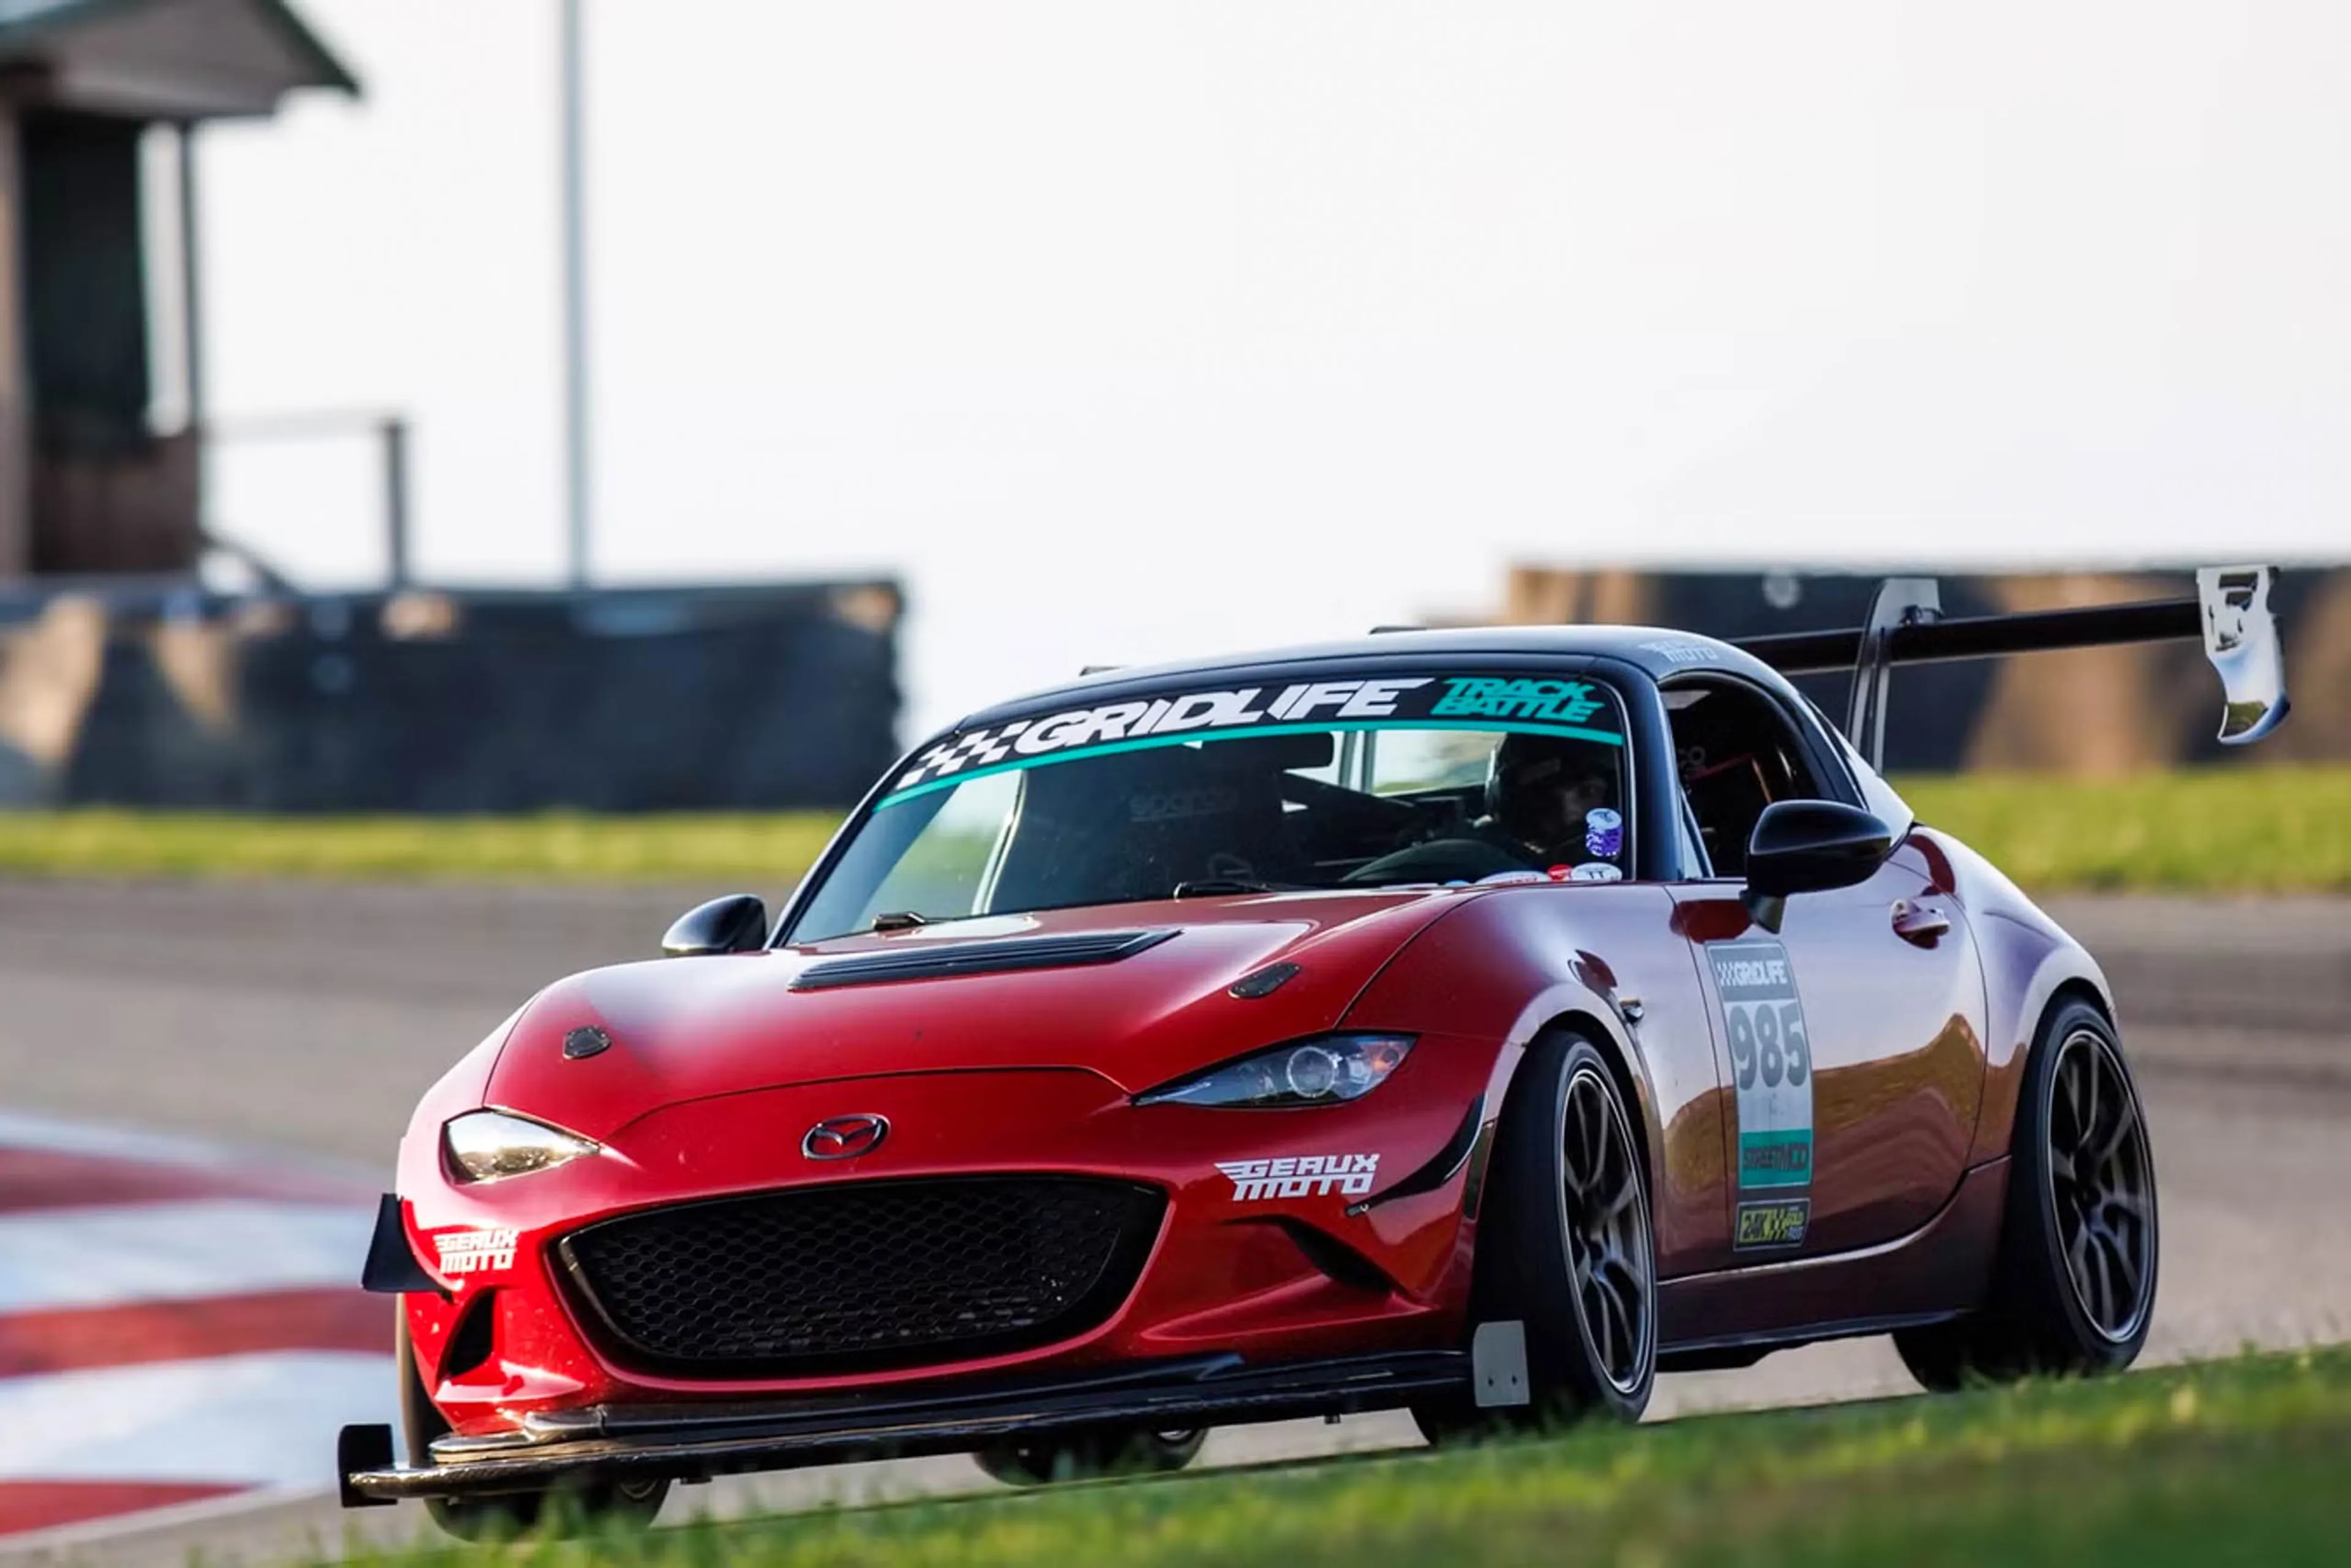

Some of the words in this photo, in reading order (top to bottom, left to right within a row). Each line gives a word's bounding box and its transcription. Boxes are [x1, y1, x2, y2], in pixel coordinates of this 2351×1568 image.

[1443, 677, 1594, 700] TRACK
[1016, 678, 1434, 754] GRIDLIFE
[1430, 696, 1604, 722] BATTLE
[1734, 960, 1788, 986] GRIDLIFE
[1729, 1002, 1808, 1090] 985
[1214, 1153, 1380, 1179] GEAUX
[1233, 1174, 1374, 1201] MOTO
[433, 1229, 519, 1252] GEAUX
[441, 1249, 516, 1273] MOTO
